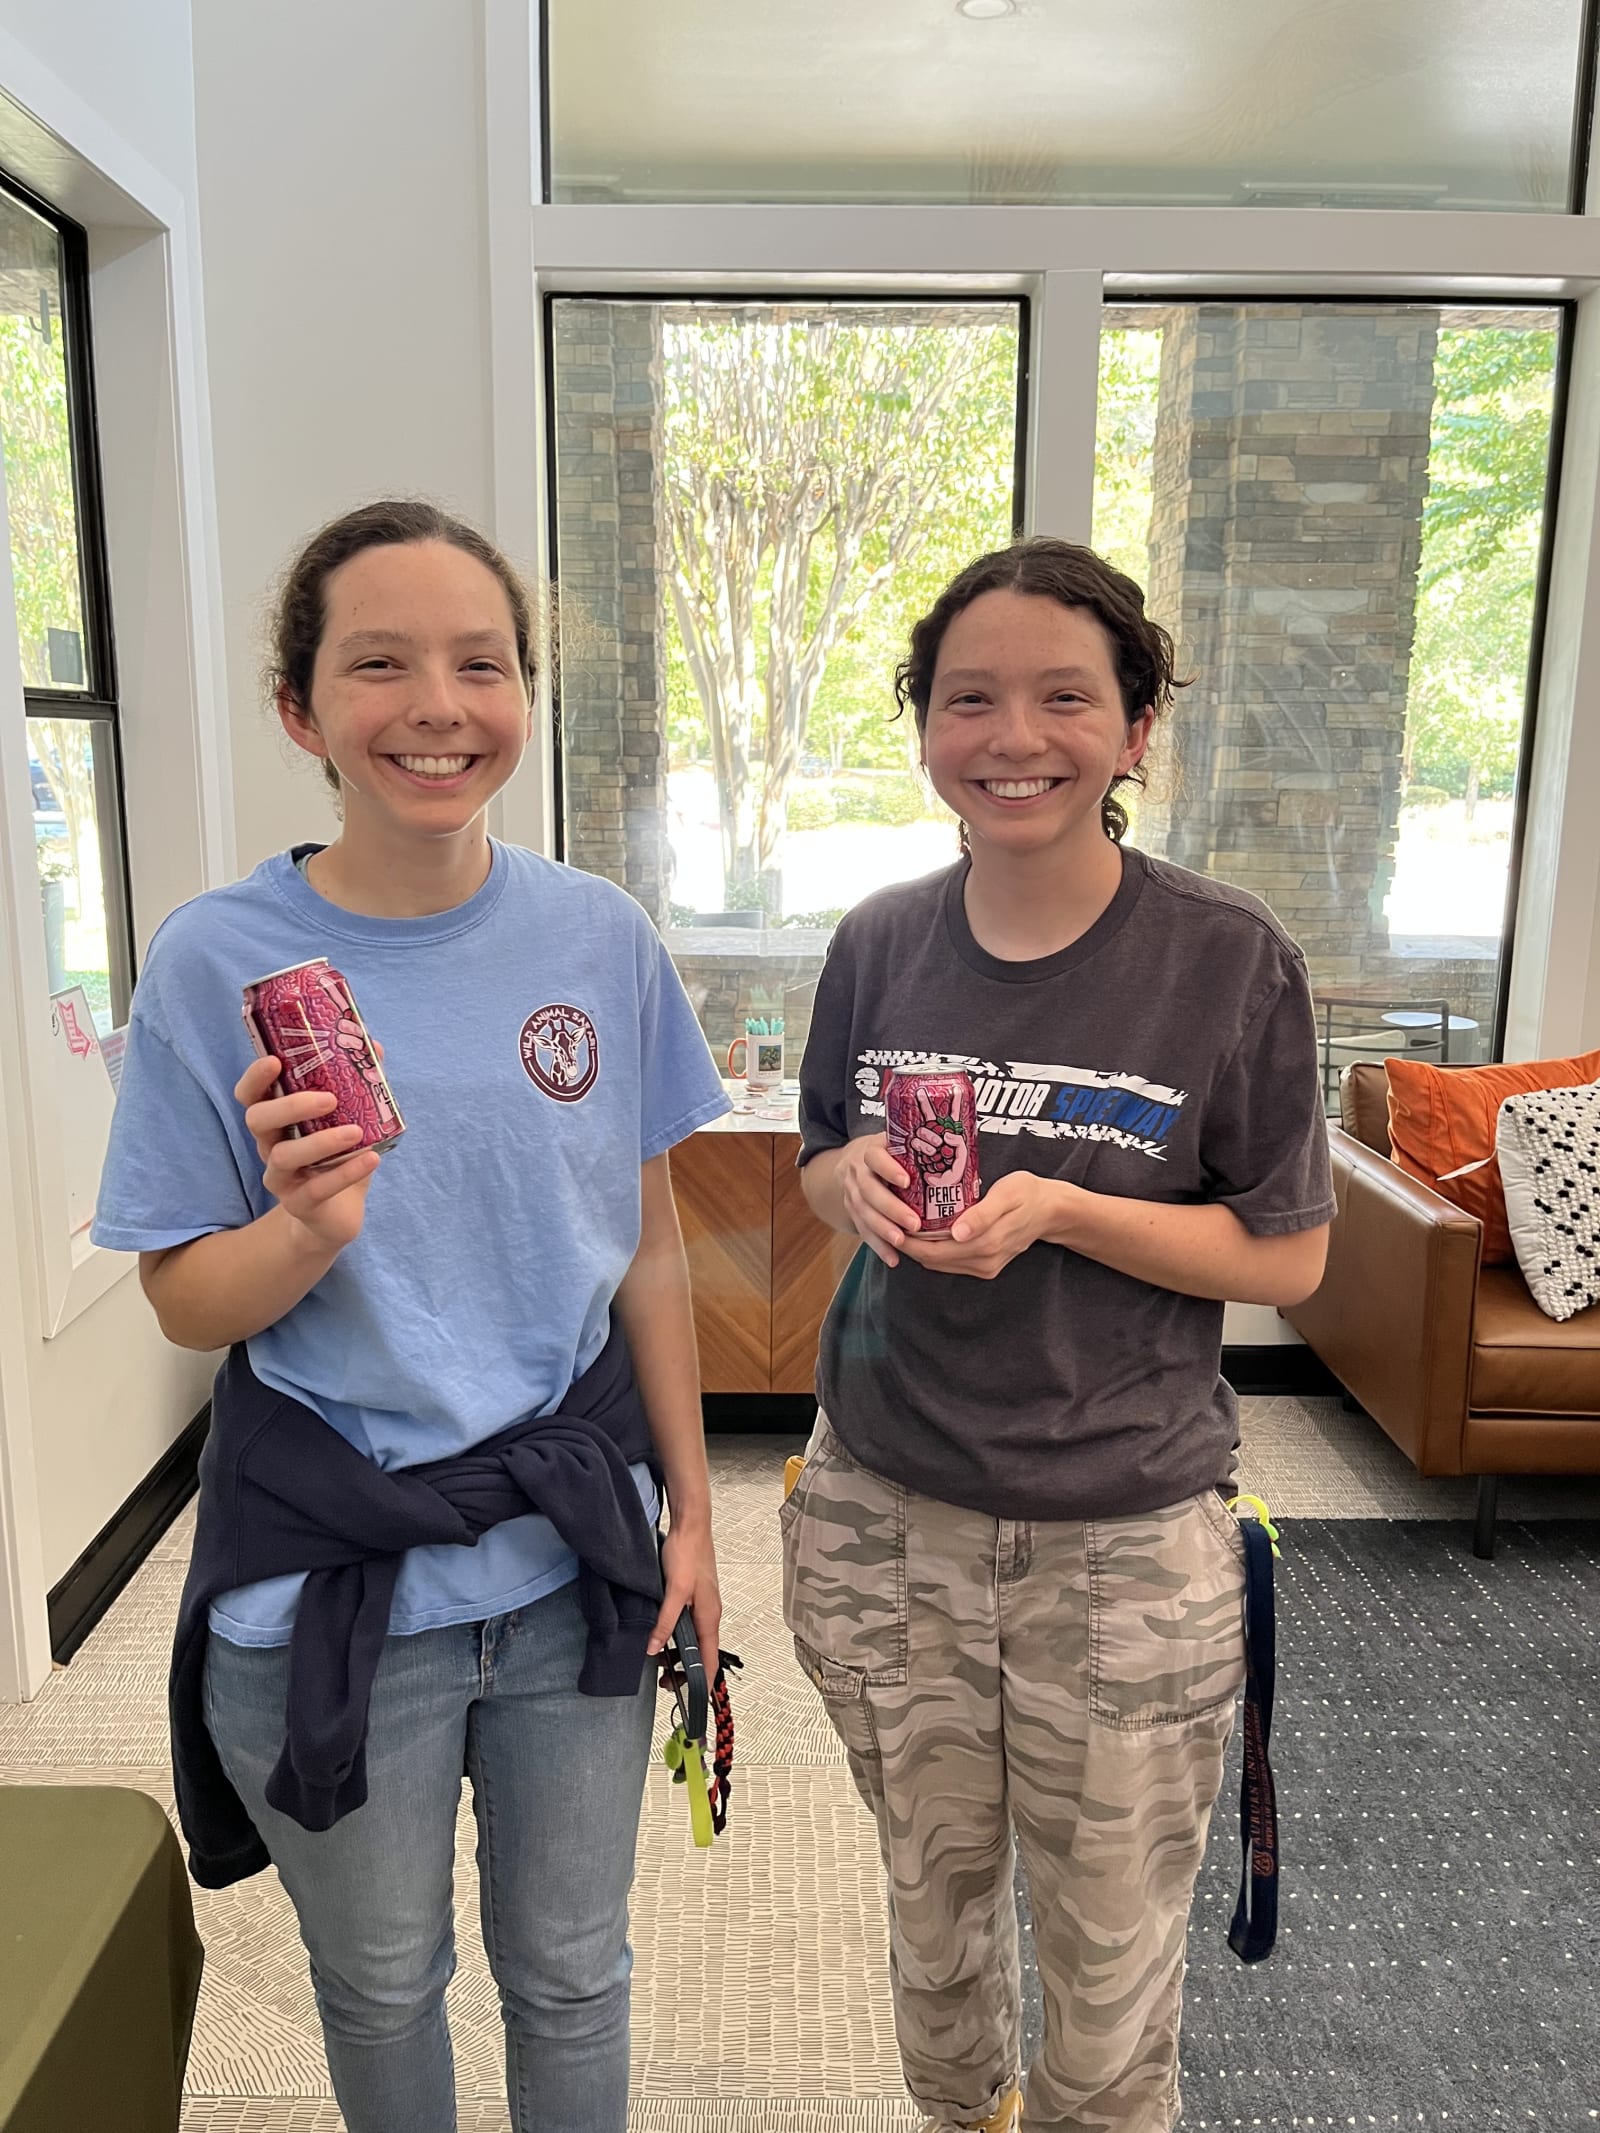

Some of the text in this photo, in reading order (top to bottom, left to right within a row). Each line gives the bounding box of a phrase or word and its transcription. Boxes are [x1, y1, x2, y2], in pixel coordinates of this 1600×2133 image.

[522, 1007, 597, 1059] WILD ANIMAL SAFARI
[928, 1185, 962, 1204] PEACE
[935, 1203, 957, 1218] TEA
[1248, 1786, 1261, 1846] AUBURN
[1264, 1819, 1274, 1849] OFFICE
